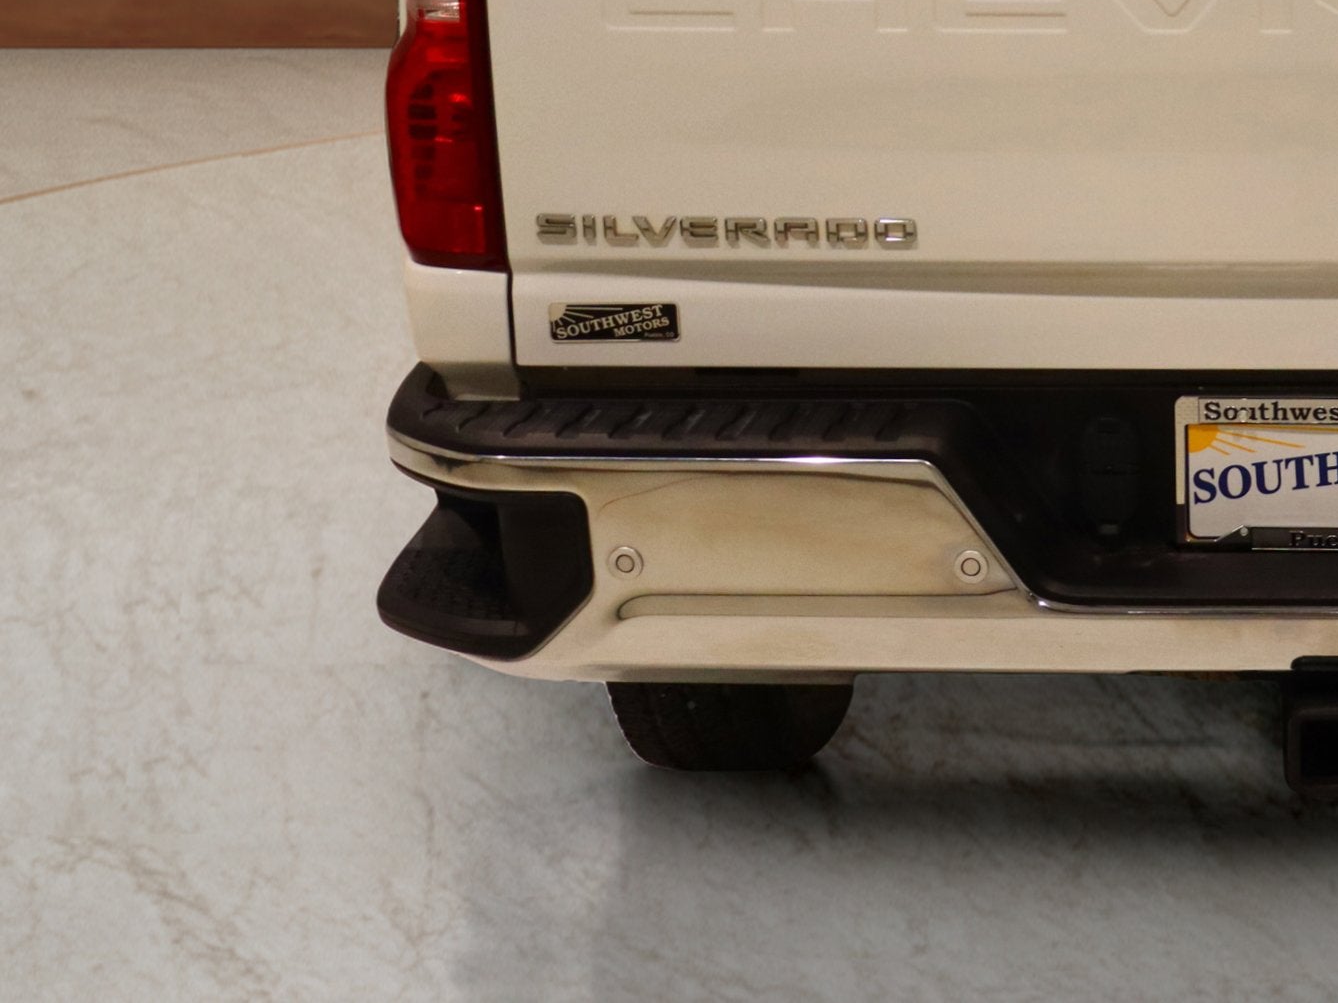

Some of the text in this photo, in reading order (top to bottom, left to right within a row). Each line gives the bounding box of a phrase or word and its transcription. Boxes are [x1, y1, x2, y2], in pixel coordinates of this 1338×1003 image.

[535, 212, 918, 248] SILVERADO
[556, 304, 663, 339] SOUTHWEST
[613, 316, 670, 337] MOTORS
